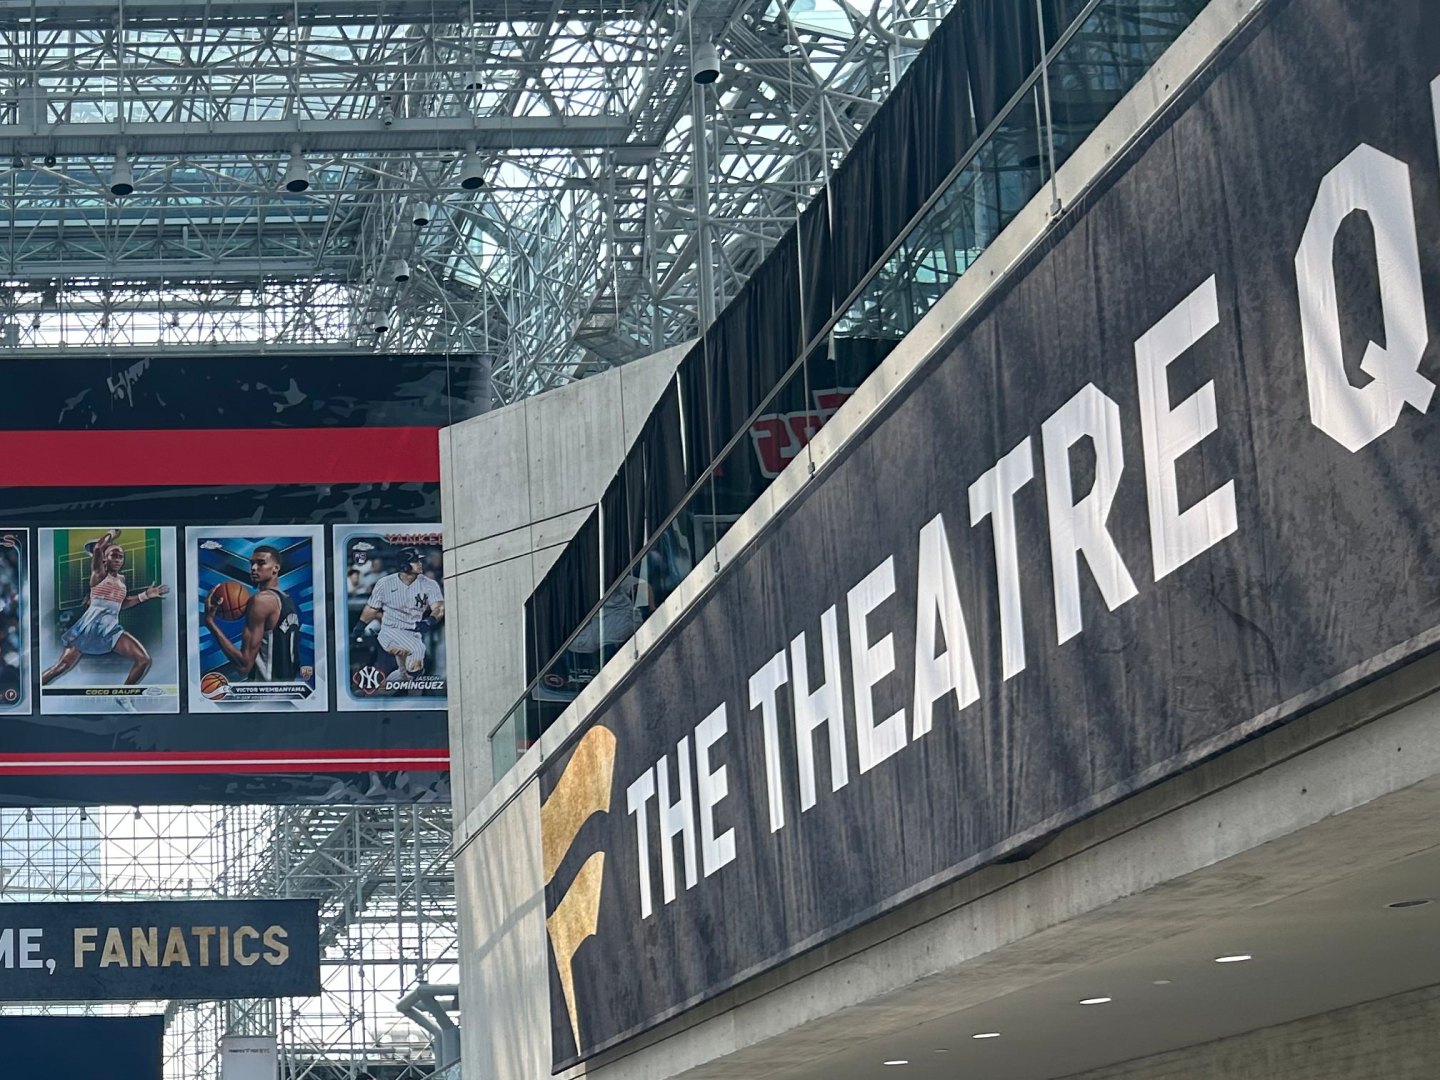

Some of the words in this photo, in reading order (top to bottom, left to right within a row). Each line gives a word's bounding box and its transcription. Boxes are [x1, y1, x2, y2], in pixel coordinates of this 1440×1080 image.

[626, 702, 737, 920] THE
[749, 273, 1239, 834] THEATRE
[1294, 78, 1440, 453] Q
[74, 925, 290, 968] FANATICS
